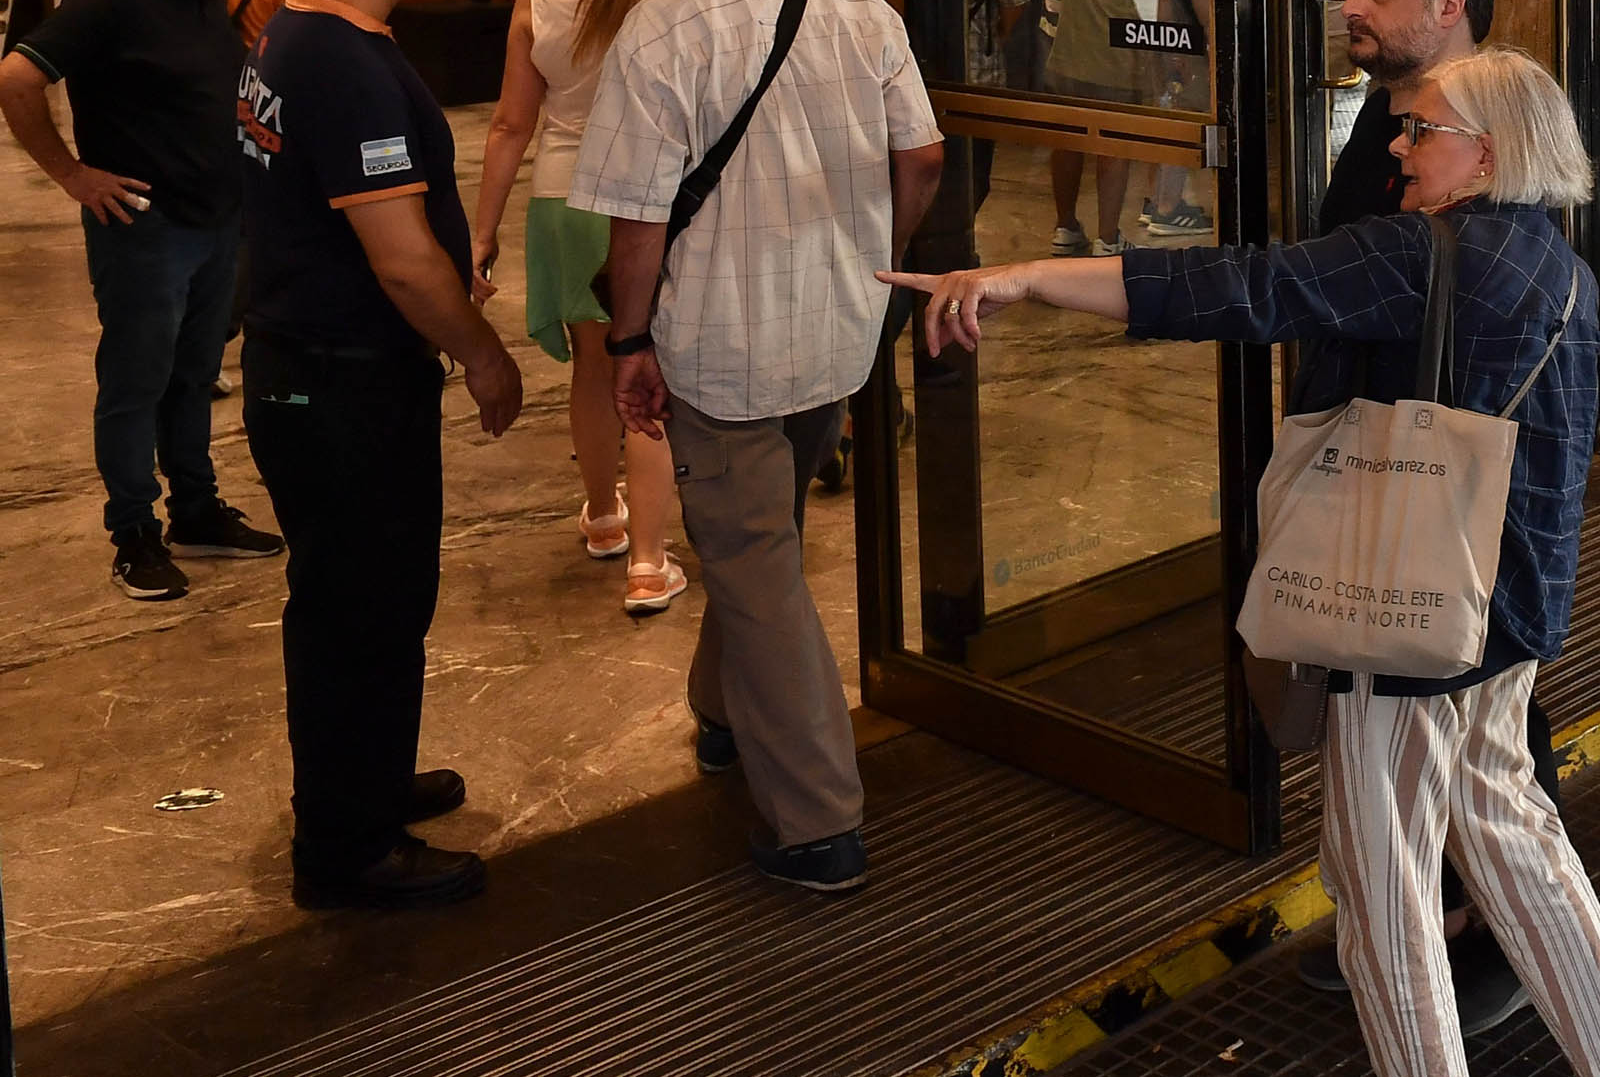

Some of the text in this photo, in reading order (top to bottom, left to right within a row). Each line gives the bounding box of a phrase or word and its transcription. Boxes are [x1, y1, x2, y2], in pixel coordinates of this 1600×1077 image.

[1125, 22, 1192, 50] SALIDA
[366, 160, 410, 173] SEGURIDAD
[1267, 566, 1323, 592] CARILO
[1334, 581, 1377, 603] COSTA
[1381, 589, 1406, 606] DEL
[1411, 591, 1445, 608] ESTE
[1274, 589, 1430, 629] PINAMAR NORTE
